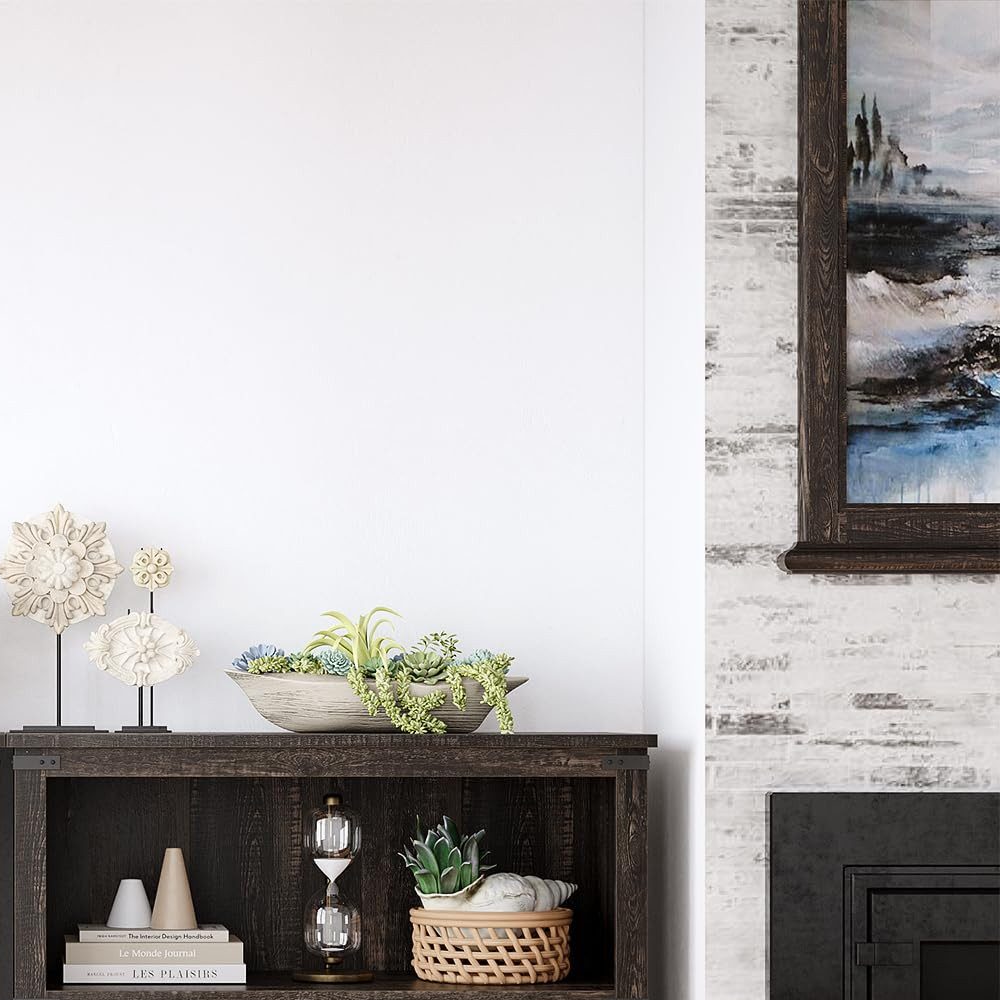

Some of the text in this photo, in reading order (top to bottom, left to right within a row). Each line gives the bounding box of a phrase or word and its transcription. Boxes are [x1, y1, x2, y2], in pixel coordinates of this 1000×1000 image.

[119, 949, 196, 959] Le Monde Journal
[133, 970, 218, 979] LES PLAISIRS
